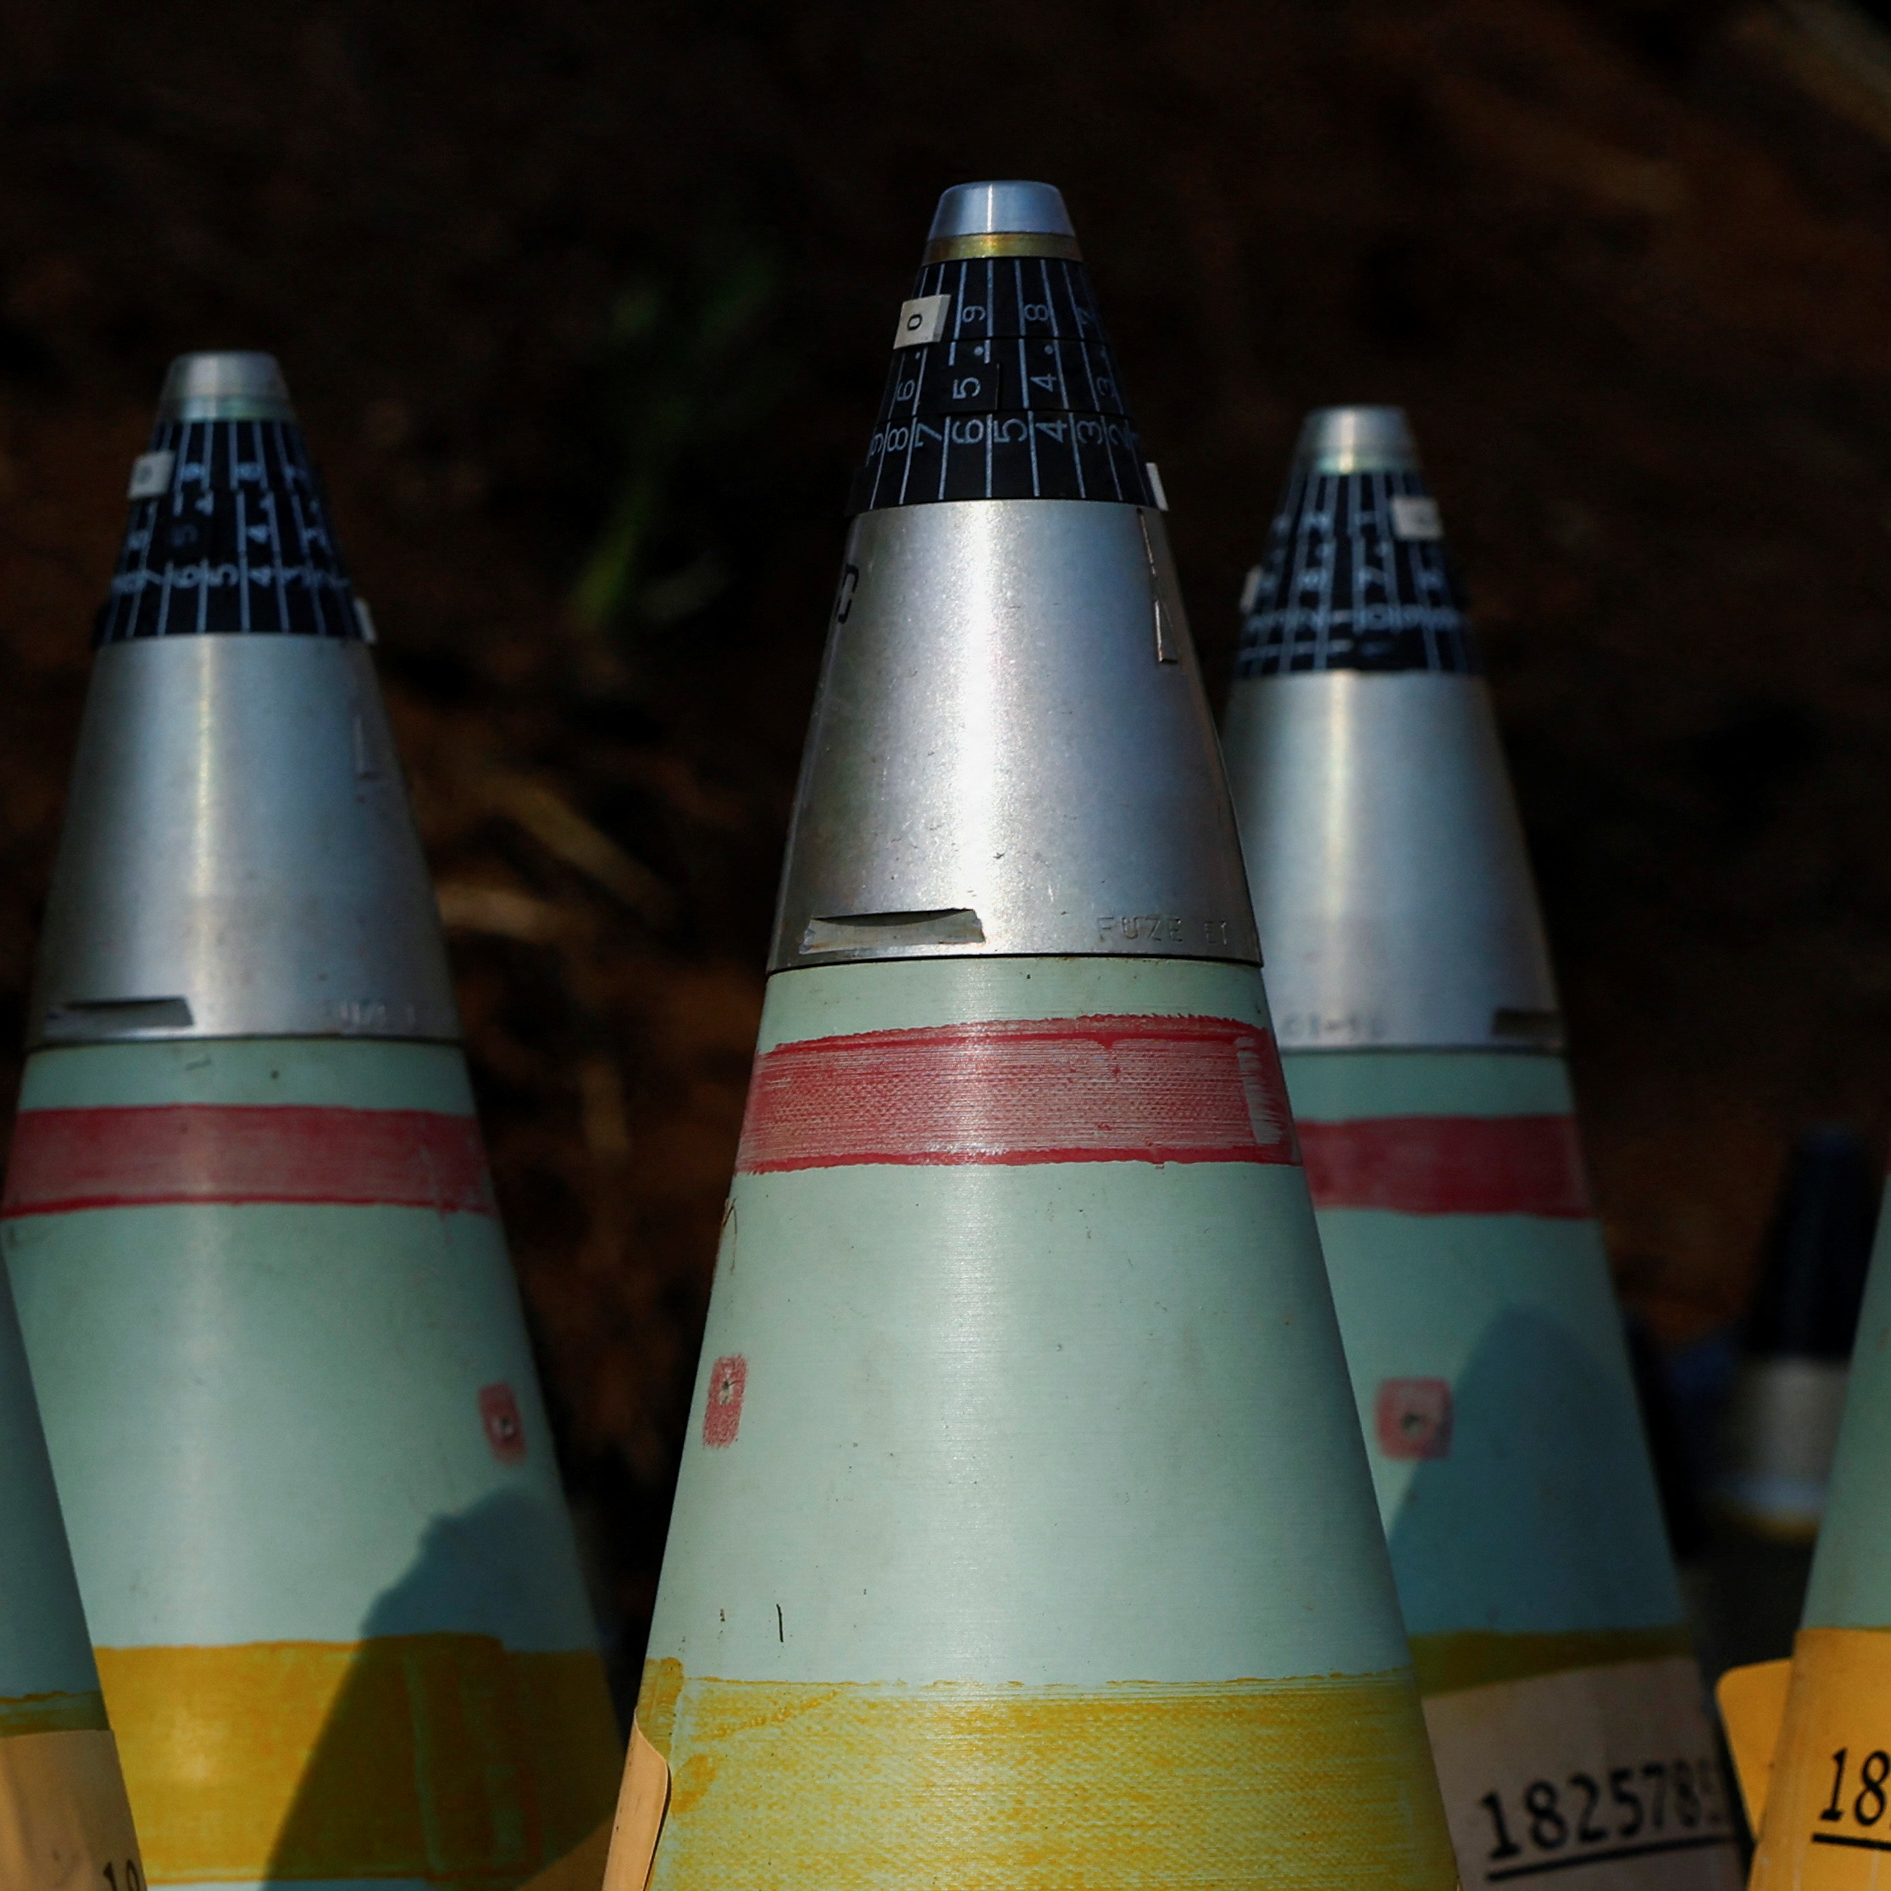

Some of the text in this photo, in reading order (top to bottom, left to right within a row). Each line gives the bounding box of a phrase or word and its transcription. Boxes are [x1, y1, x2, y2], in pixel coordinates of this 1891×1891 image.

[962, 304, 987, 324] 9
[1023, 303, 1050, 322] 8
[1096, 915, 1185, 942] FUZE
